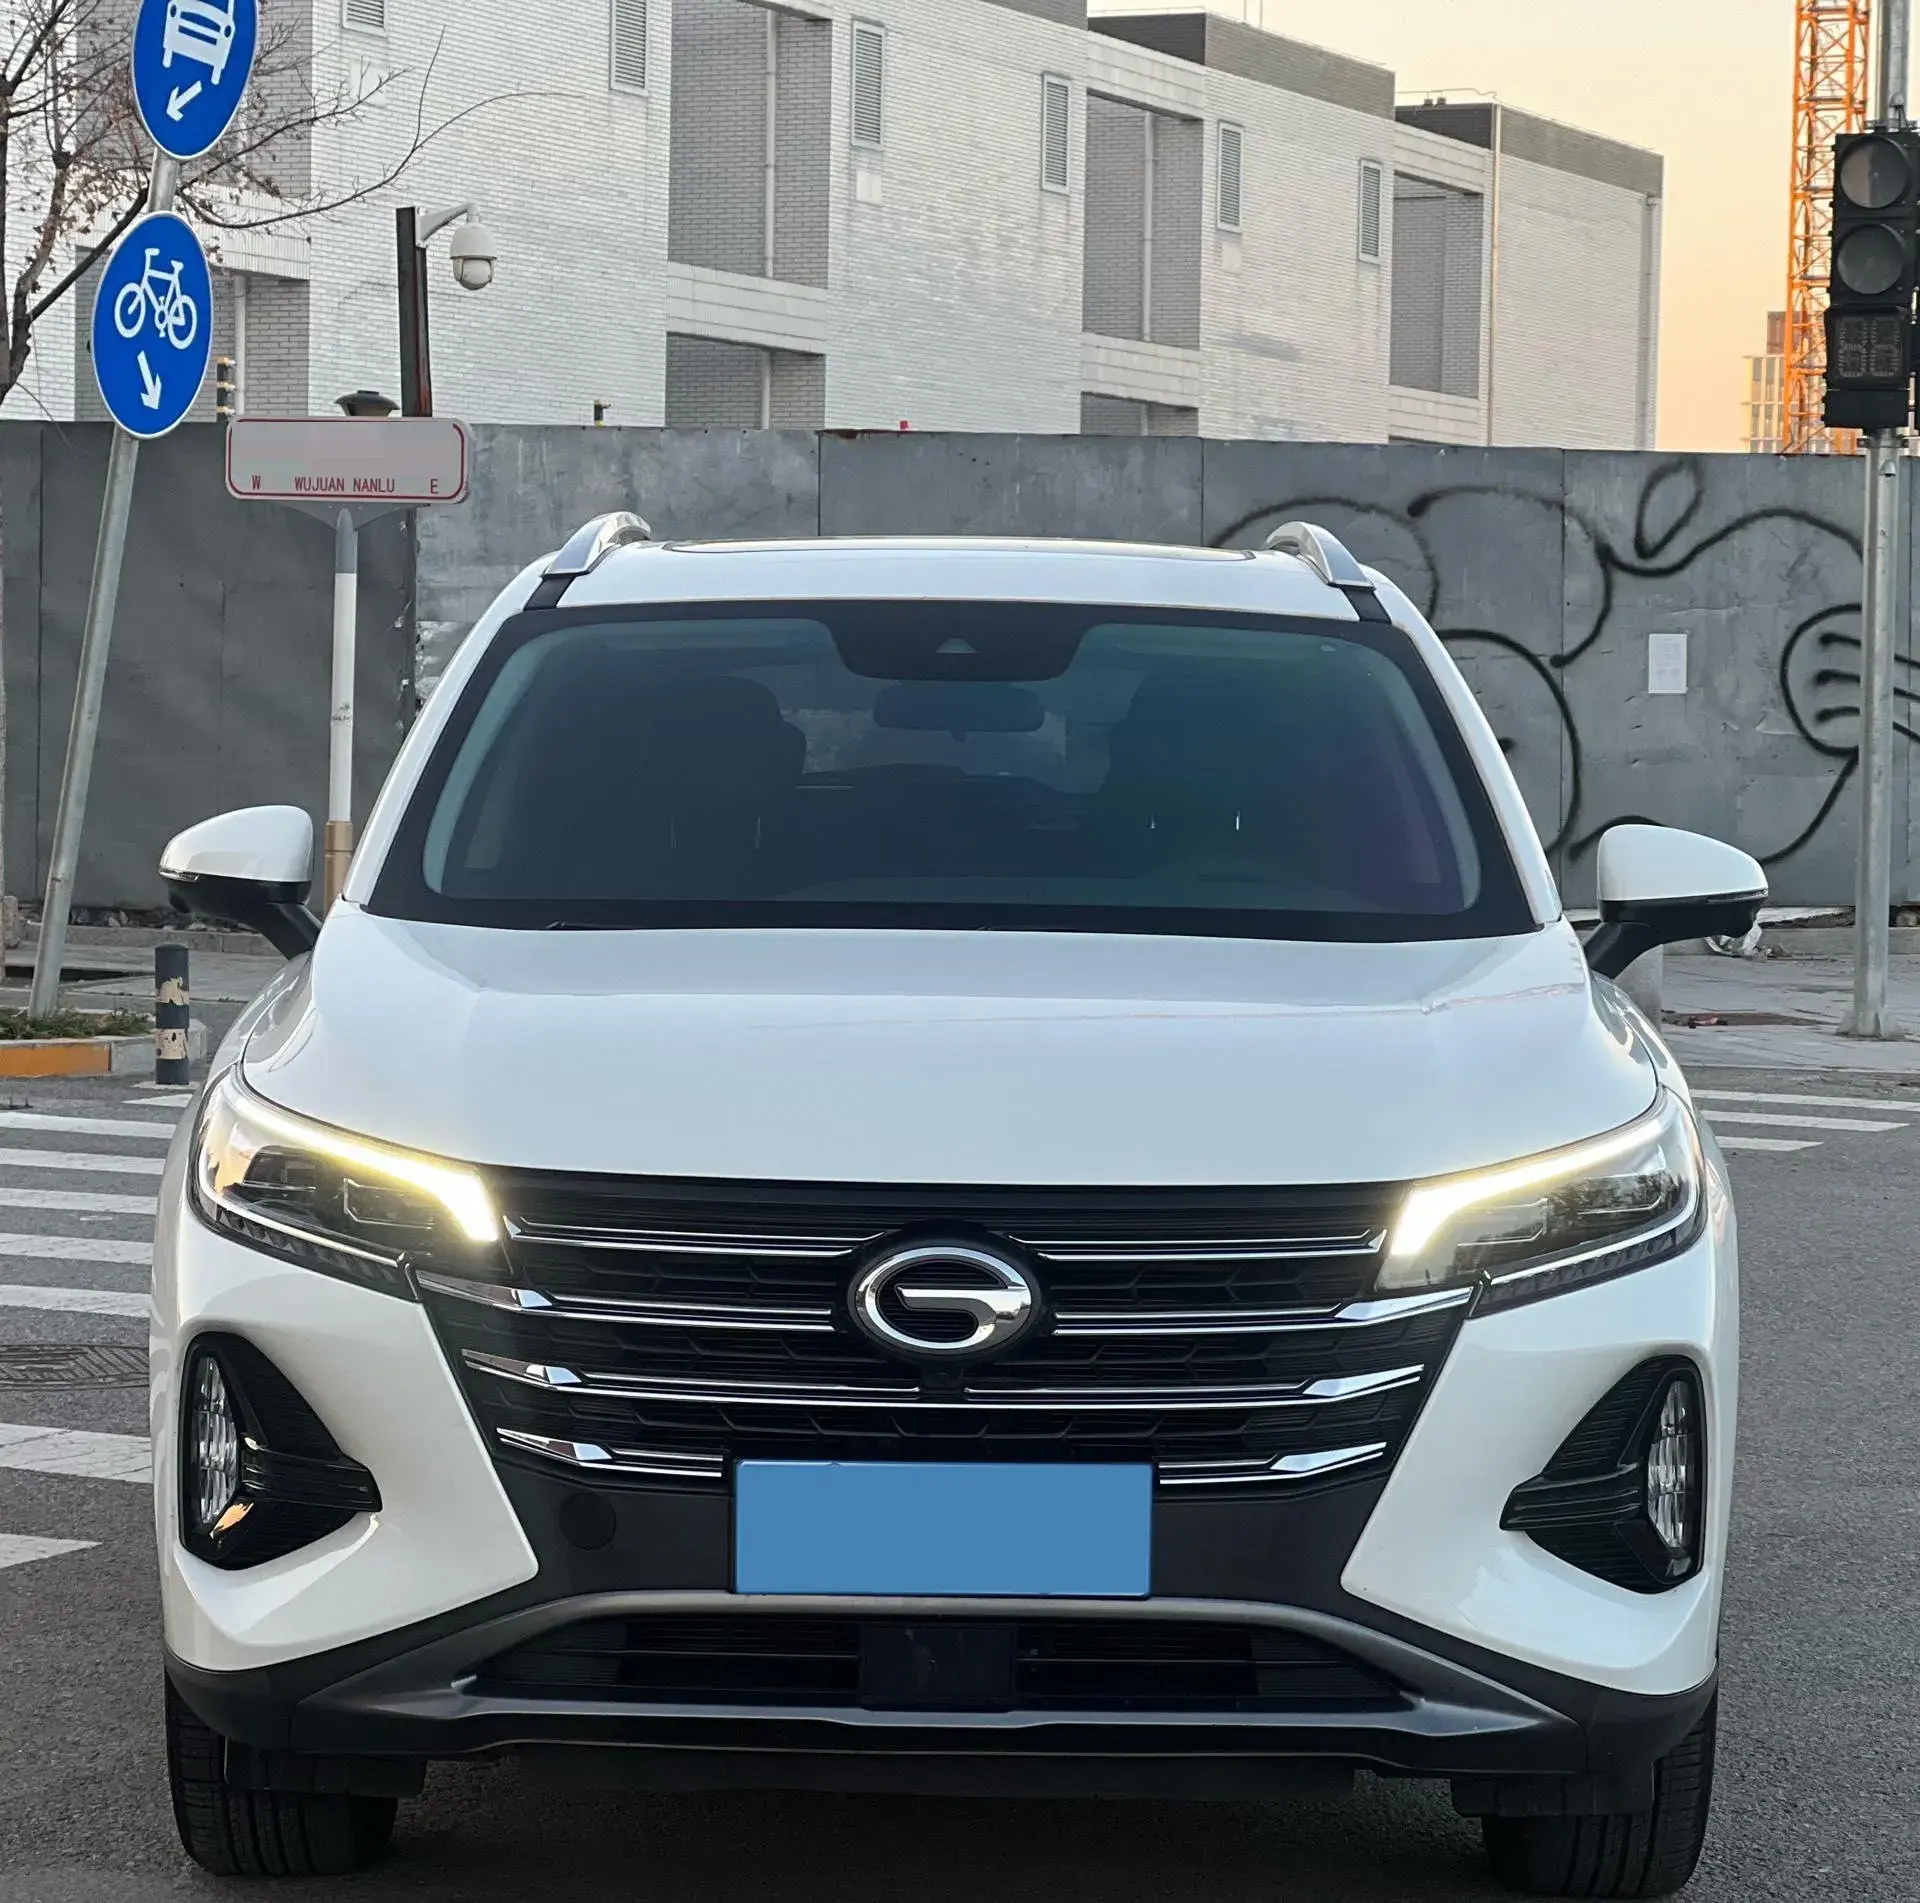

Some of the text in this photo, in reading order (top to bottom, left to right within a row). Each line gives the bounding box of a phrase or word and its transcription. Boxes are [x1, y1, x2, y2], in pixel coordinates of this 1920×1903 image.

[251, 475, 438, 494] W WUJUAN NANLU E
